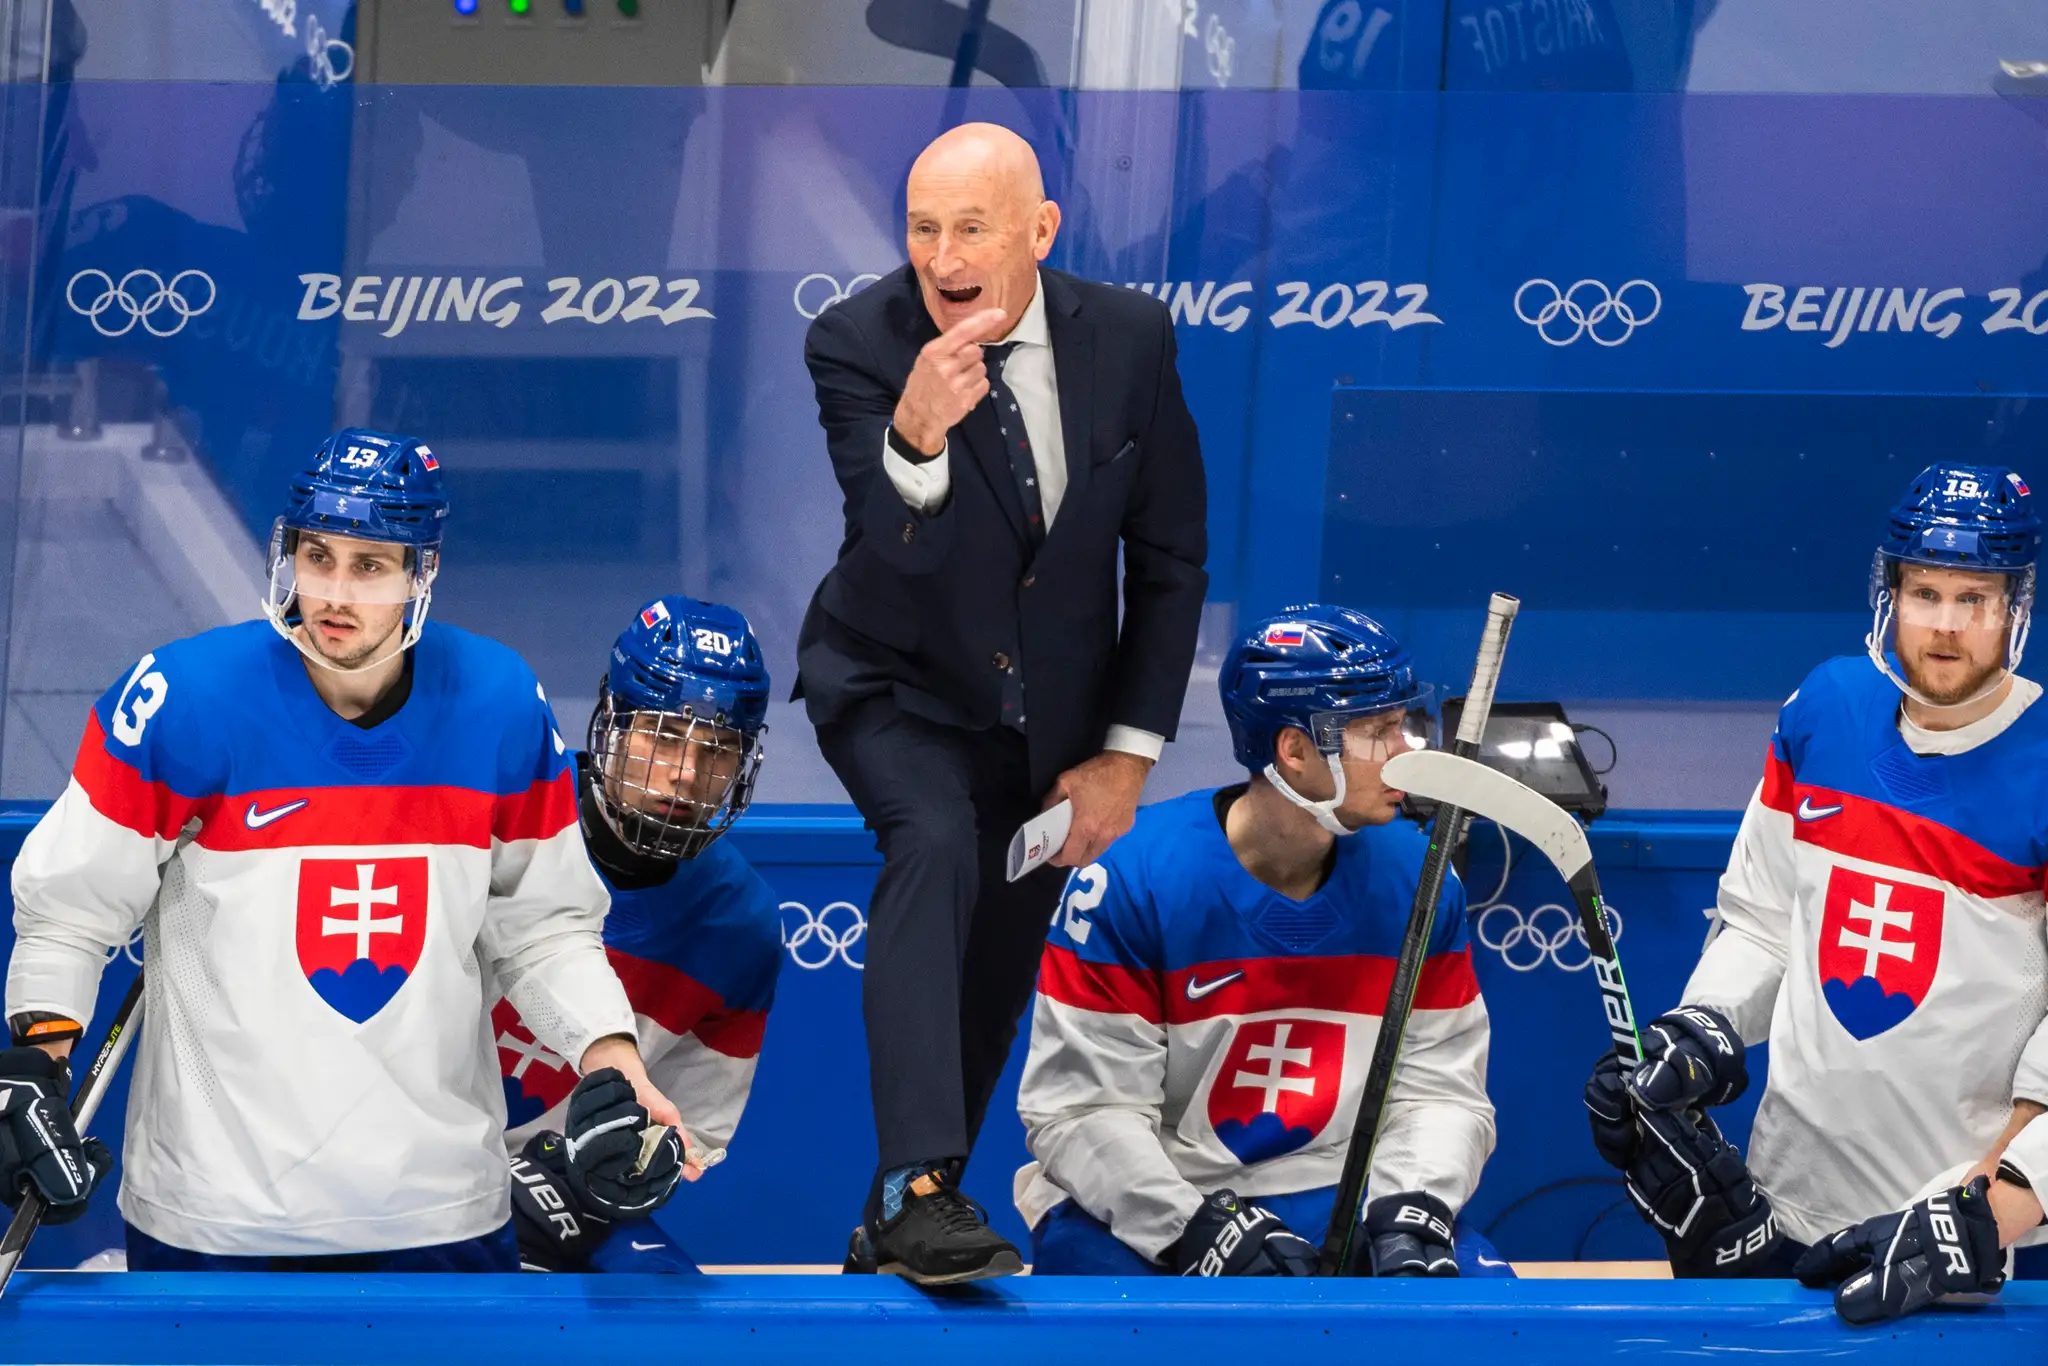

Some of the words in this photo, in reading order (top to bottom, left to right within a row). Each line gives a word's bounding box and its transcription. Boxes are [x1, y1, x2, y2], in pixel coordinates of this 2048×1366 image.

[297, 273, 523, 337] BEIJING
[541, 276, 717, 326] 2022
[1269, 280, 1445, 331] 2022
[1741, 283, 1966, 349] BEIJING
[340, 446, 378, 467] 13
[1942, 479, 1979, 498] 19
[695, 629, 731, 656] 20
[92, 1023, 123, 1077] HYPERLITE
[61, 1148, 83, 1184] CCM
[510, 1157, 581, 1241] UER
